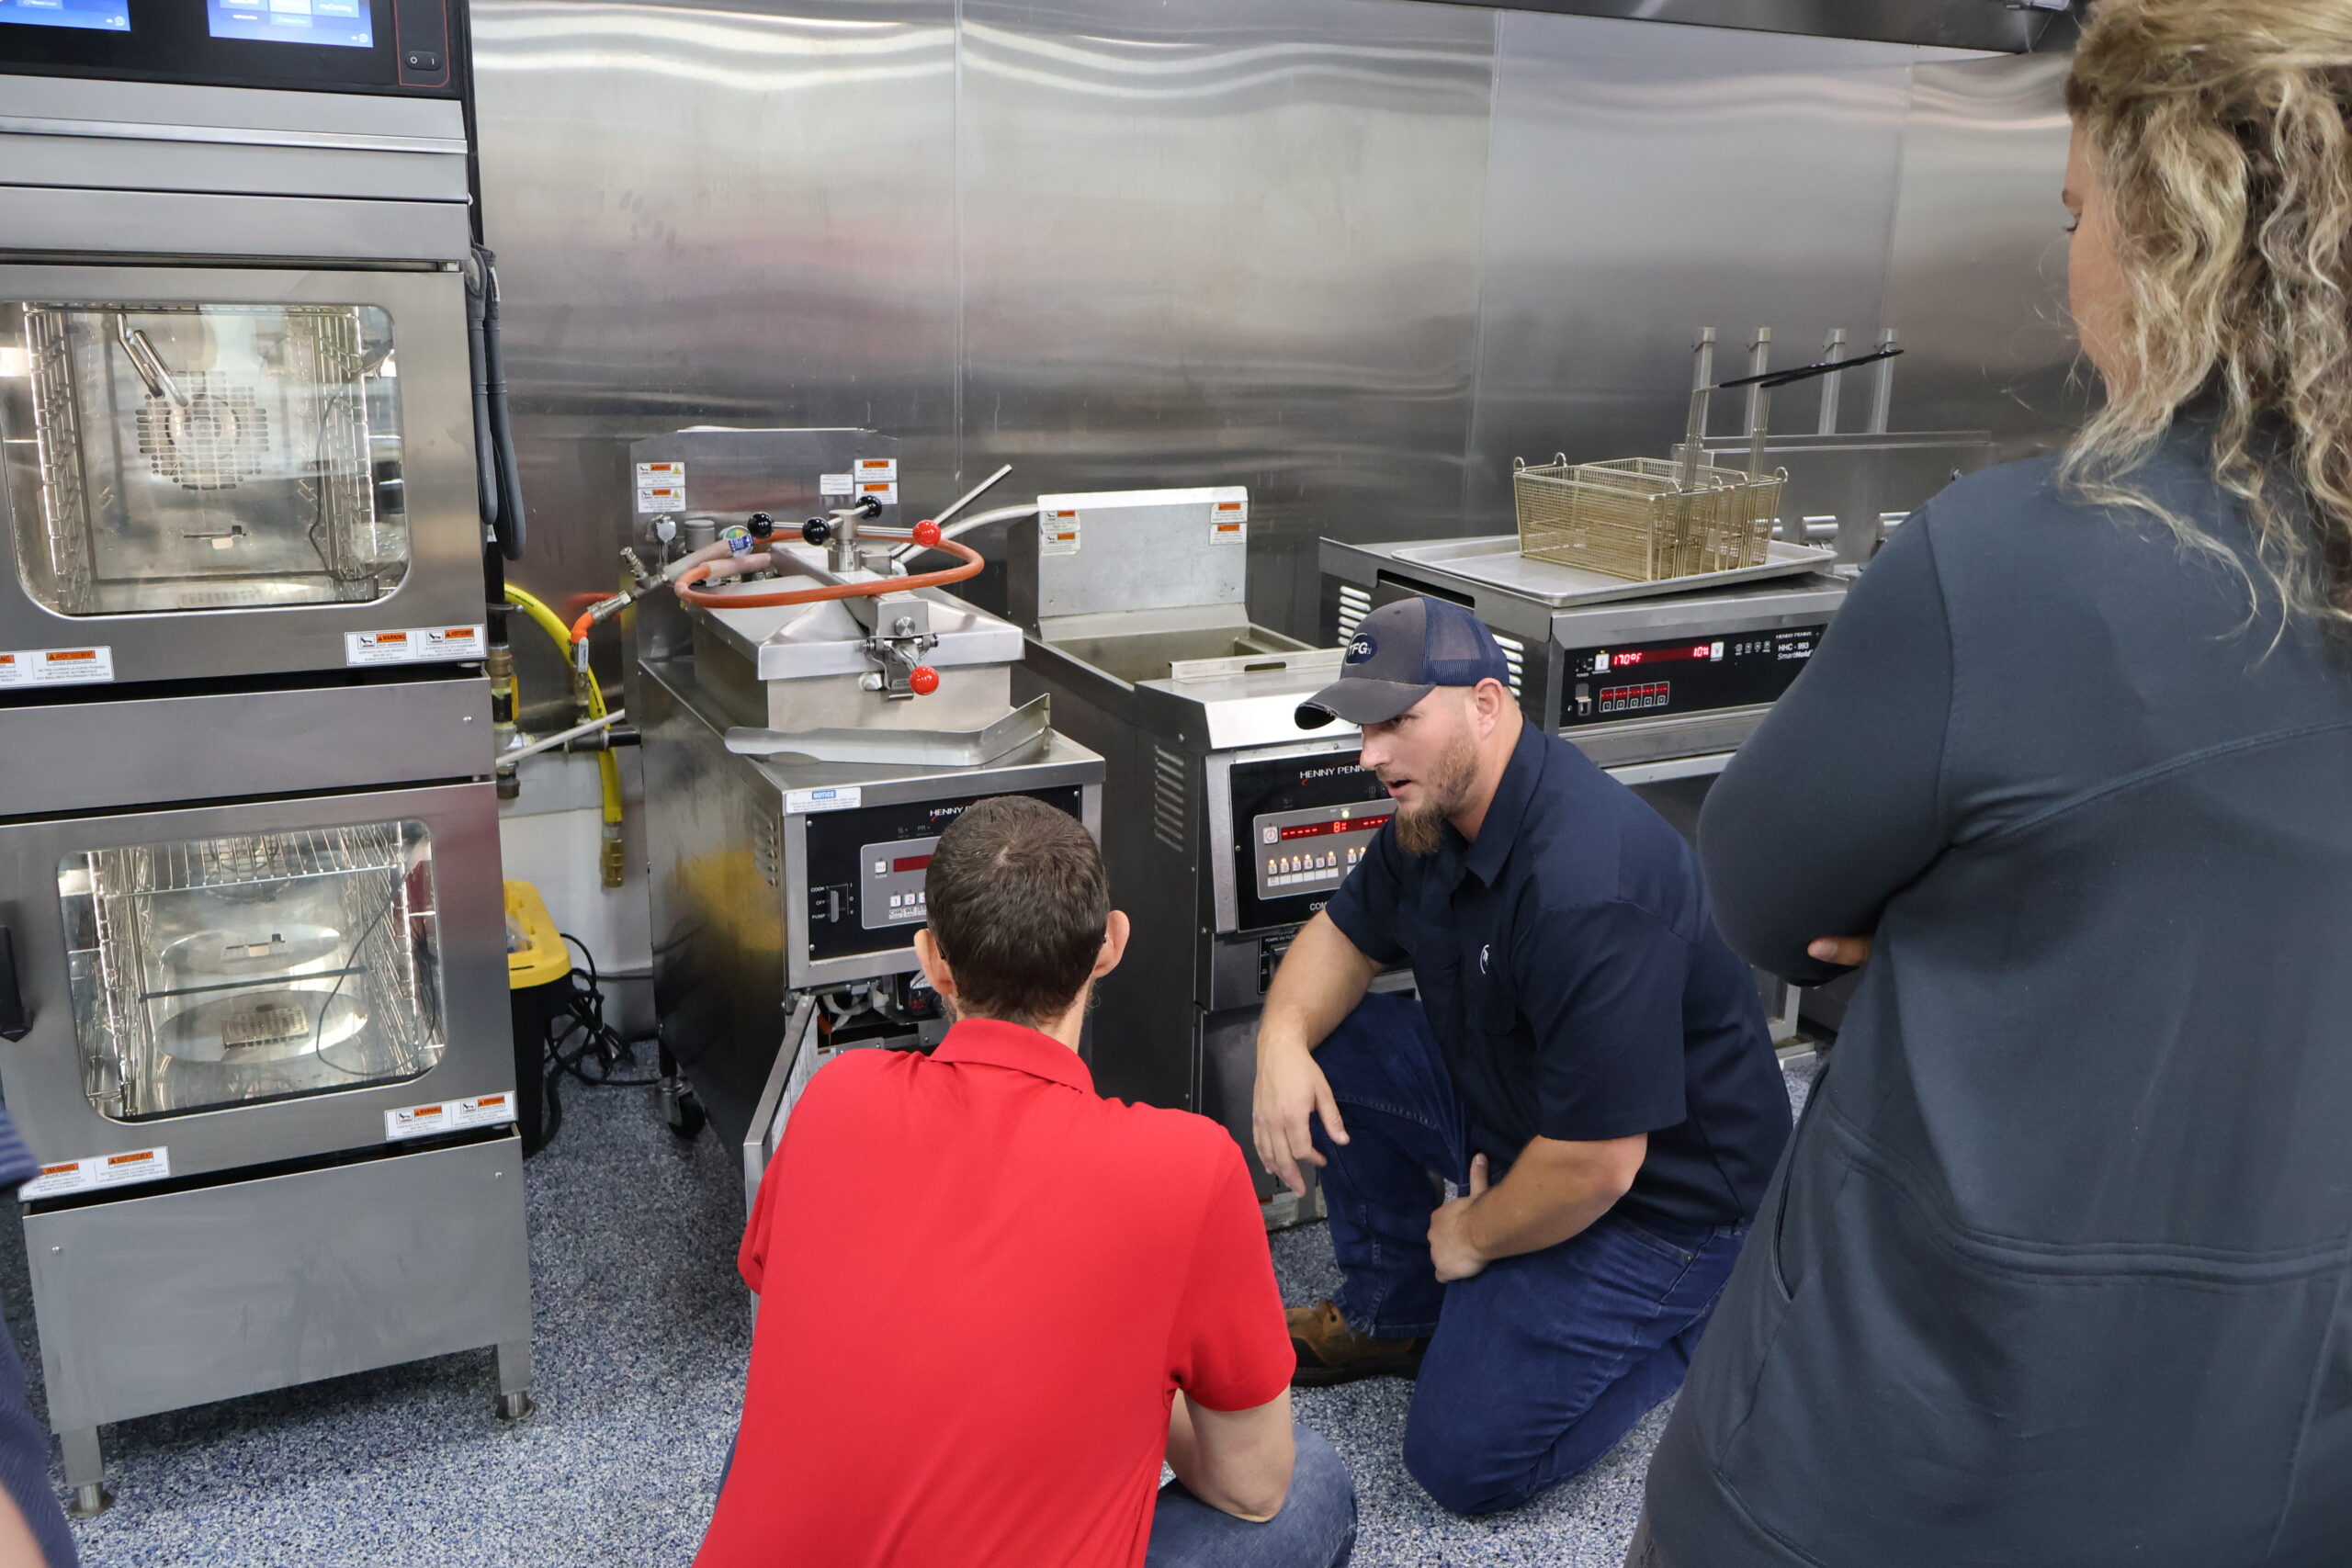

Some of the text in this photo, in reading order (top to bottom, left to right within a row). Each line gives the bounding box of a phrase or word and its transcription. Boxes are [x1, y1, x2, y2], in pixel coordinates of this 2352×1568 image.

[1299, 764, 1366, 779] HENNY PENN
[813, 791, 834, 799] NOTICE
[930, 807, 964, 817] HENNY
